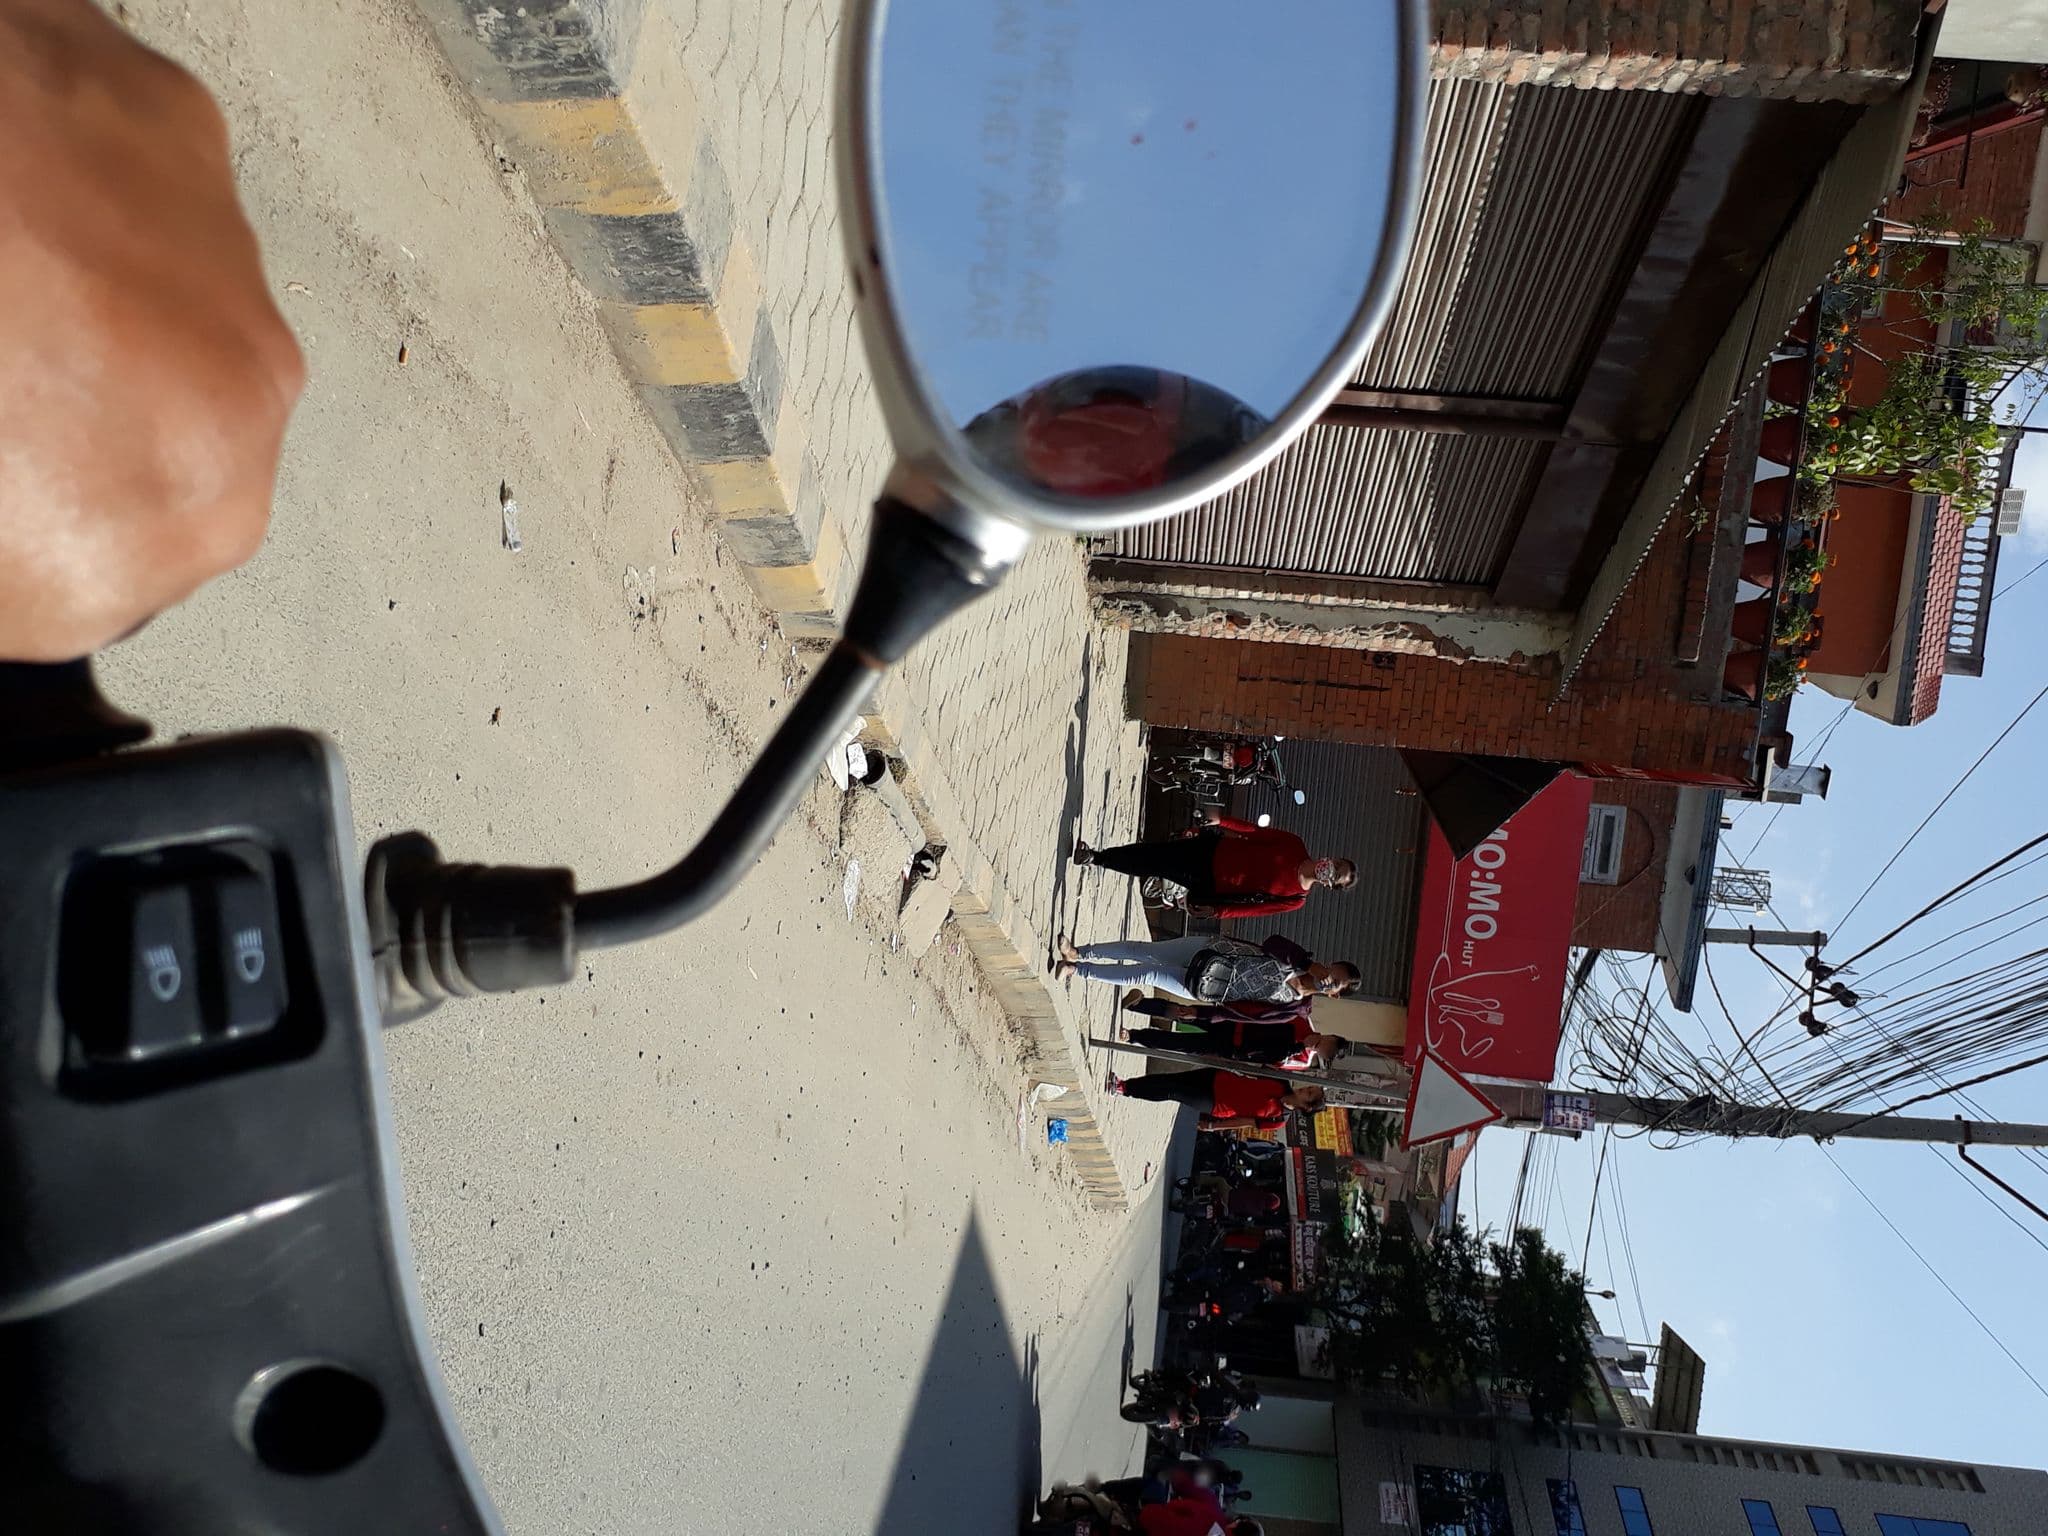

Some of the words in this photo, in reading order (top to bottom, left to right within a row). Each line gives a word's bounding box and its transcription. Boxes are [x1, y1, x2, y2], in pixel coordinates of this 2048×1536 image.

[1038, 23, 1080, 93] THE
[981, 78, 1024, 175] THEY
[1026, 107, 1071, 259] MIRROR
[967, 184, 1014, 340] APPEAR
[1014, 271, 1054, 344] ARE
[1461, 940, 1475, 968] HUT
[1306, 1175, 1321, 1213] KOUTURE
